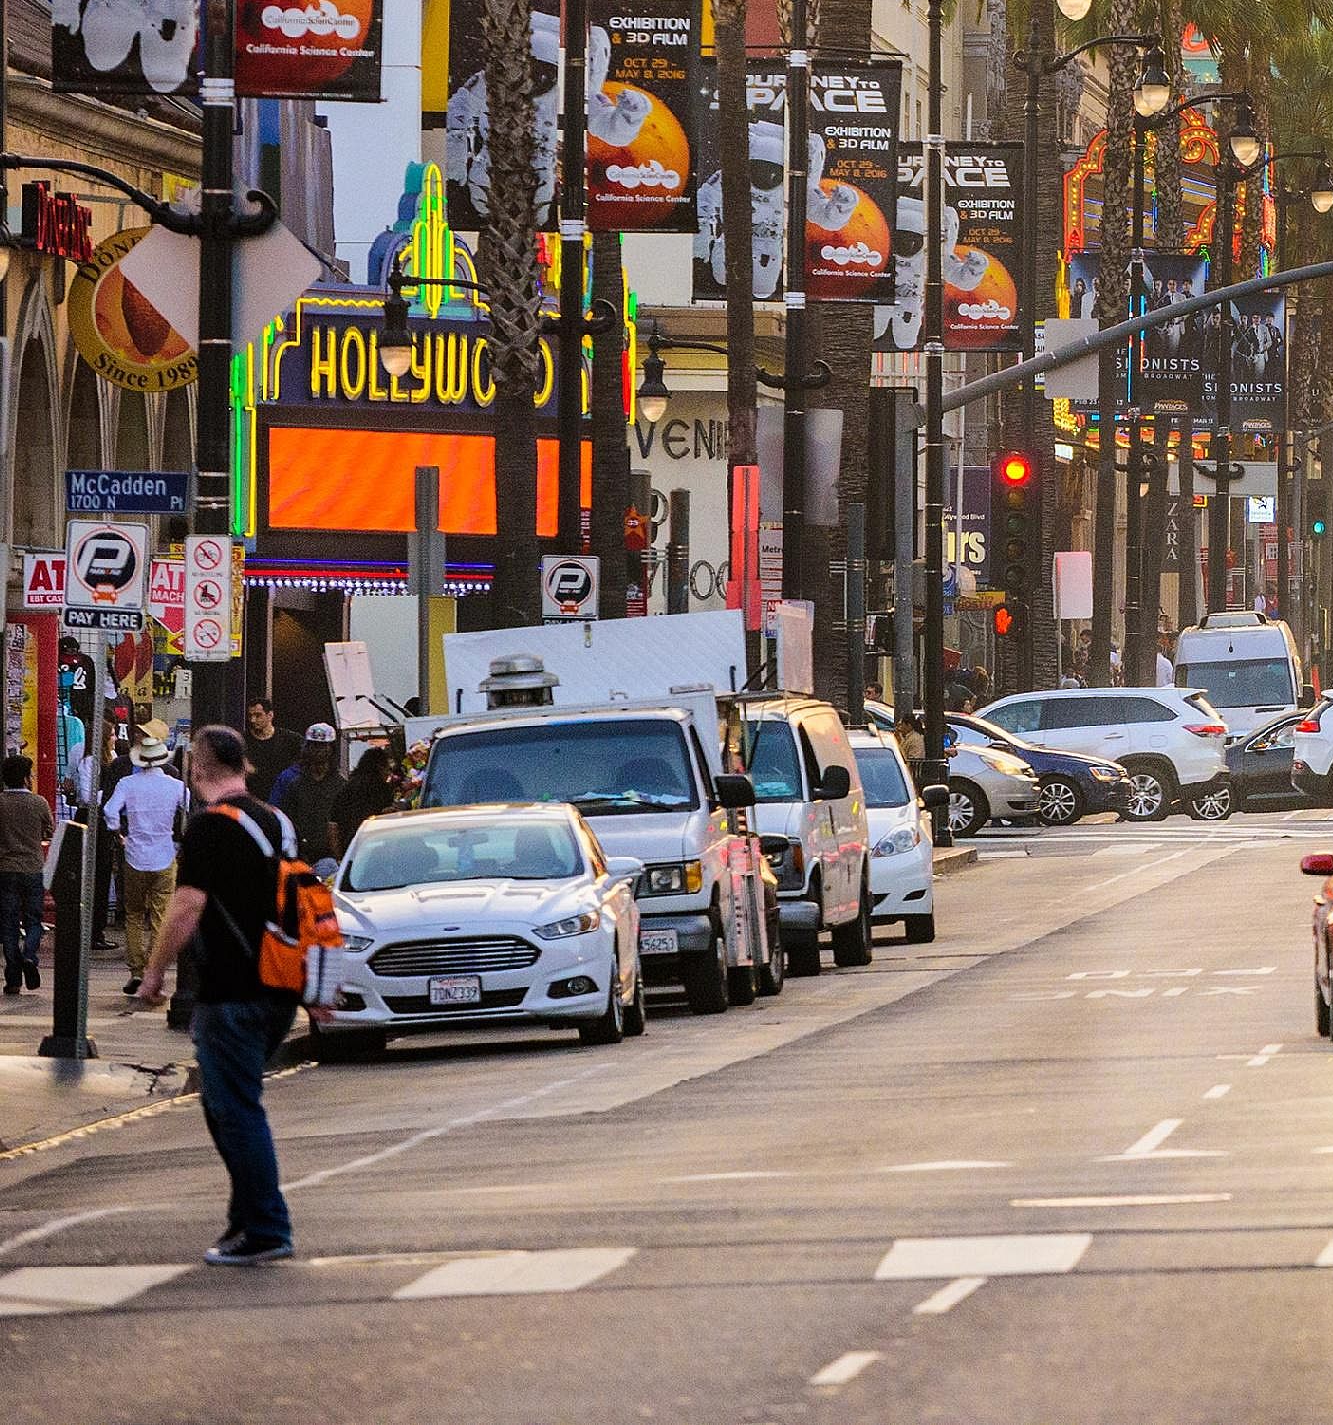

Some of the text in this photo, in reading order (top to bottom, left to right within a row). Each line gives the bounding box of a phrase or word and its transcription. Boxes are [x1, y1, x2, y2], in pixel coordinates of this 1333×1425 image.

[609, 16, 690, 31] EXHIBITION
[627, 32, 650, 43] 3D
[653, 33, 688, 45] FILM
[246, 44, 375, 57] California Science Center
[825, 127, 891, 138] EXHIBITION
[839, 138, 889, 150] 3D FILM
[596, 193, 690, 203] California Science Center
[958, 200, 1015, 209] EXHIBITION
[970, 211, 1013, 220] 3D FILM
[812, 269, 844, 277] California
[845, 269, 868, 277] Science
[94, 354, 149, 387] Since
[71, 474, 167, 495] McCadden
[71, 496, 101, 508] 1700
[107, 496, 116, 508] N
[1165, 503, 1180, 560] ZARA
[30, 595, 45, 603] EBT
[68, 612, 138, 627] PAY HERE
